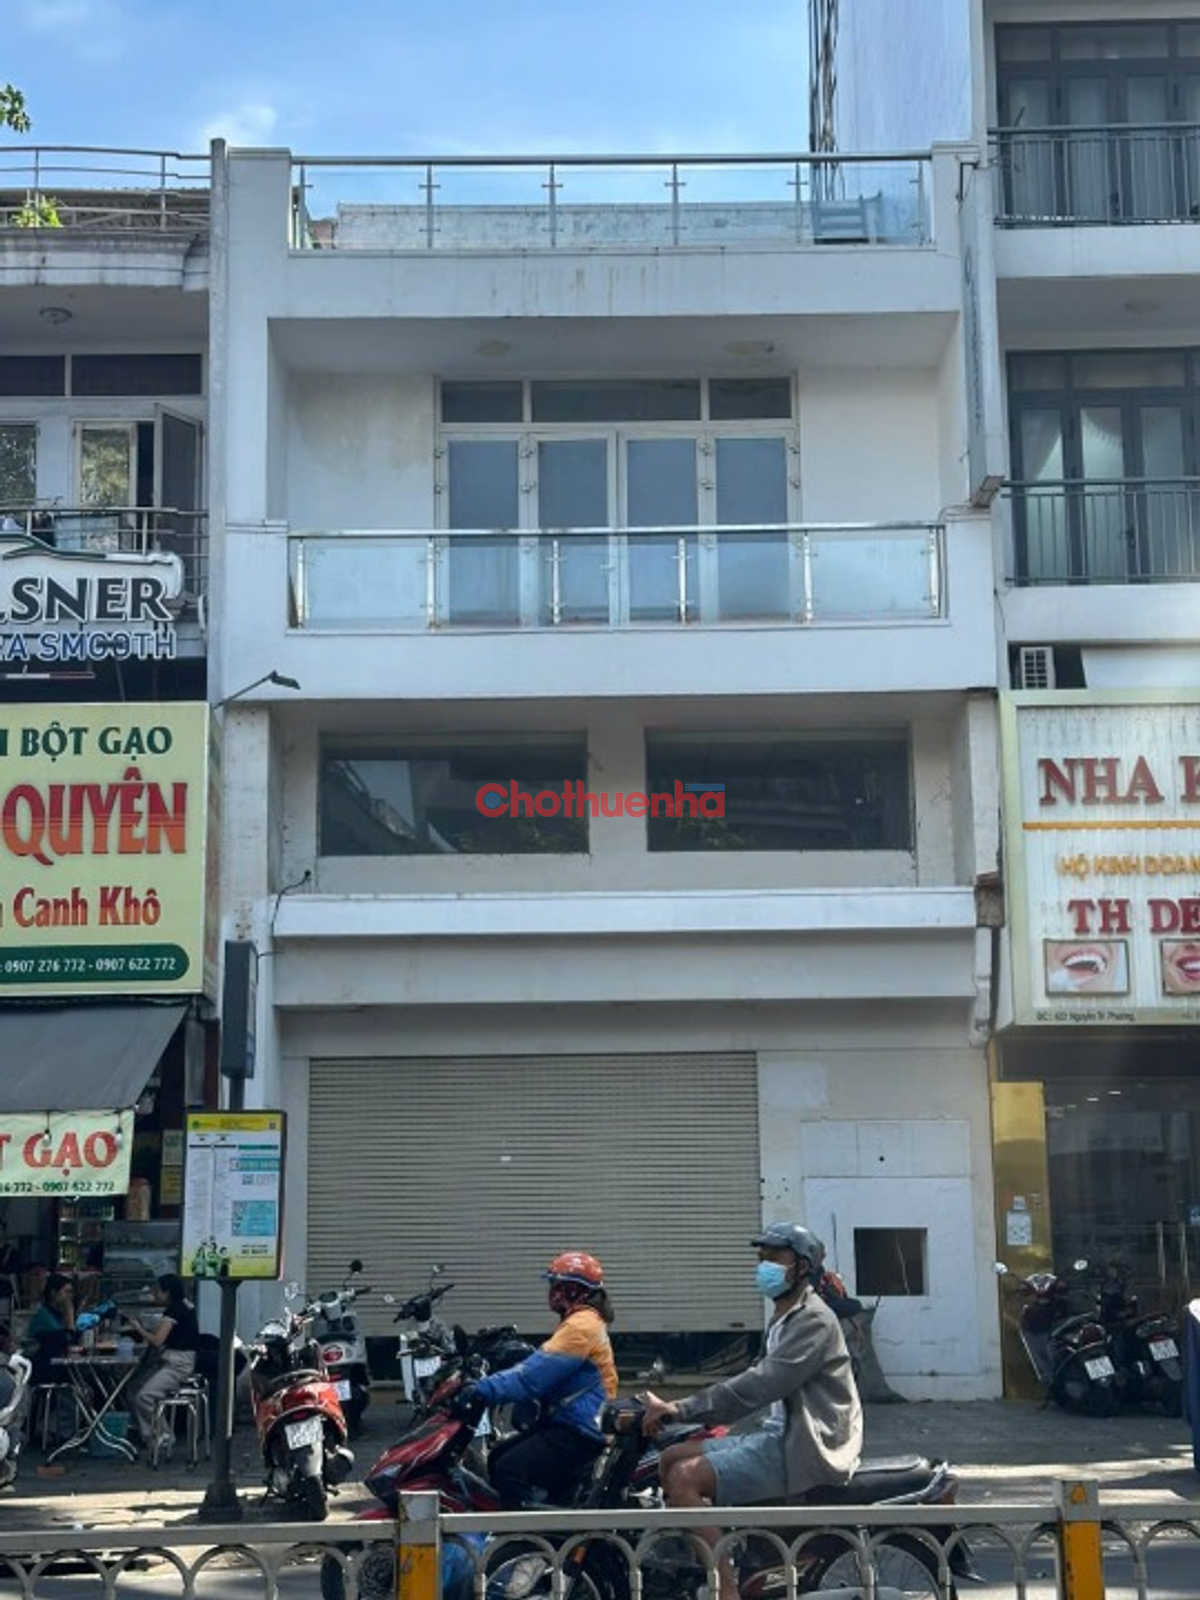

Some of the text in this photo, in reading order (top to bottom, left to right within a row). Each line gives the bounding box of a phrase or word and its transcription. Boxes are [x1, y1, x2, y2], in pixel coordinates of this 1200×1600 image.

[39, 631, 176, 661] SMOOTH
[20, 721, 88, 763] BỘT
[98, 726, 173, 762] GẠO
[1037, 755, 1165, 806] NHA
[1, 766, 188, 867] QUYÊN
[1094, 855, 1141, 876] KINH
[13, 886, 88, 928] Canh
[98, 886, 162, 926] Khô
[1067, 898, 1200, 935] TH DE
[4, 960, 35, 973] 0907
[63, 959, 87, 972] 772
[95, 958, 125, 971] 0907
[128, 958, 151, 971] 622
[153, 958, 177, 971] 772
[22, 1130, 119, 1177] GẠO
